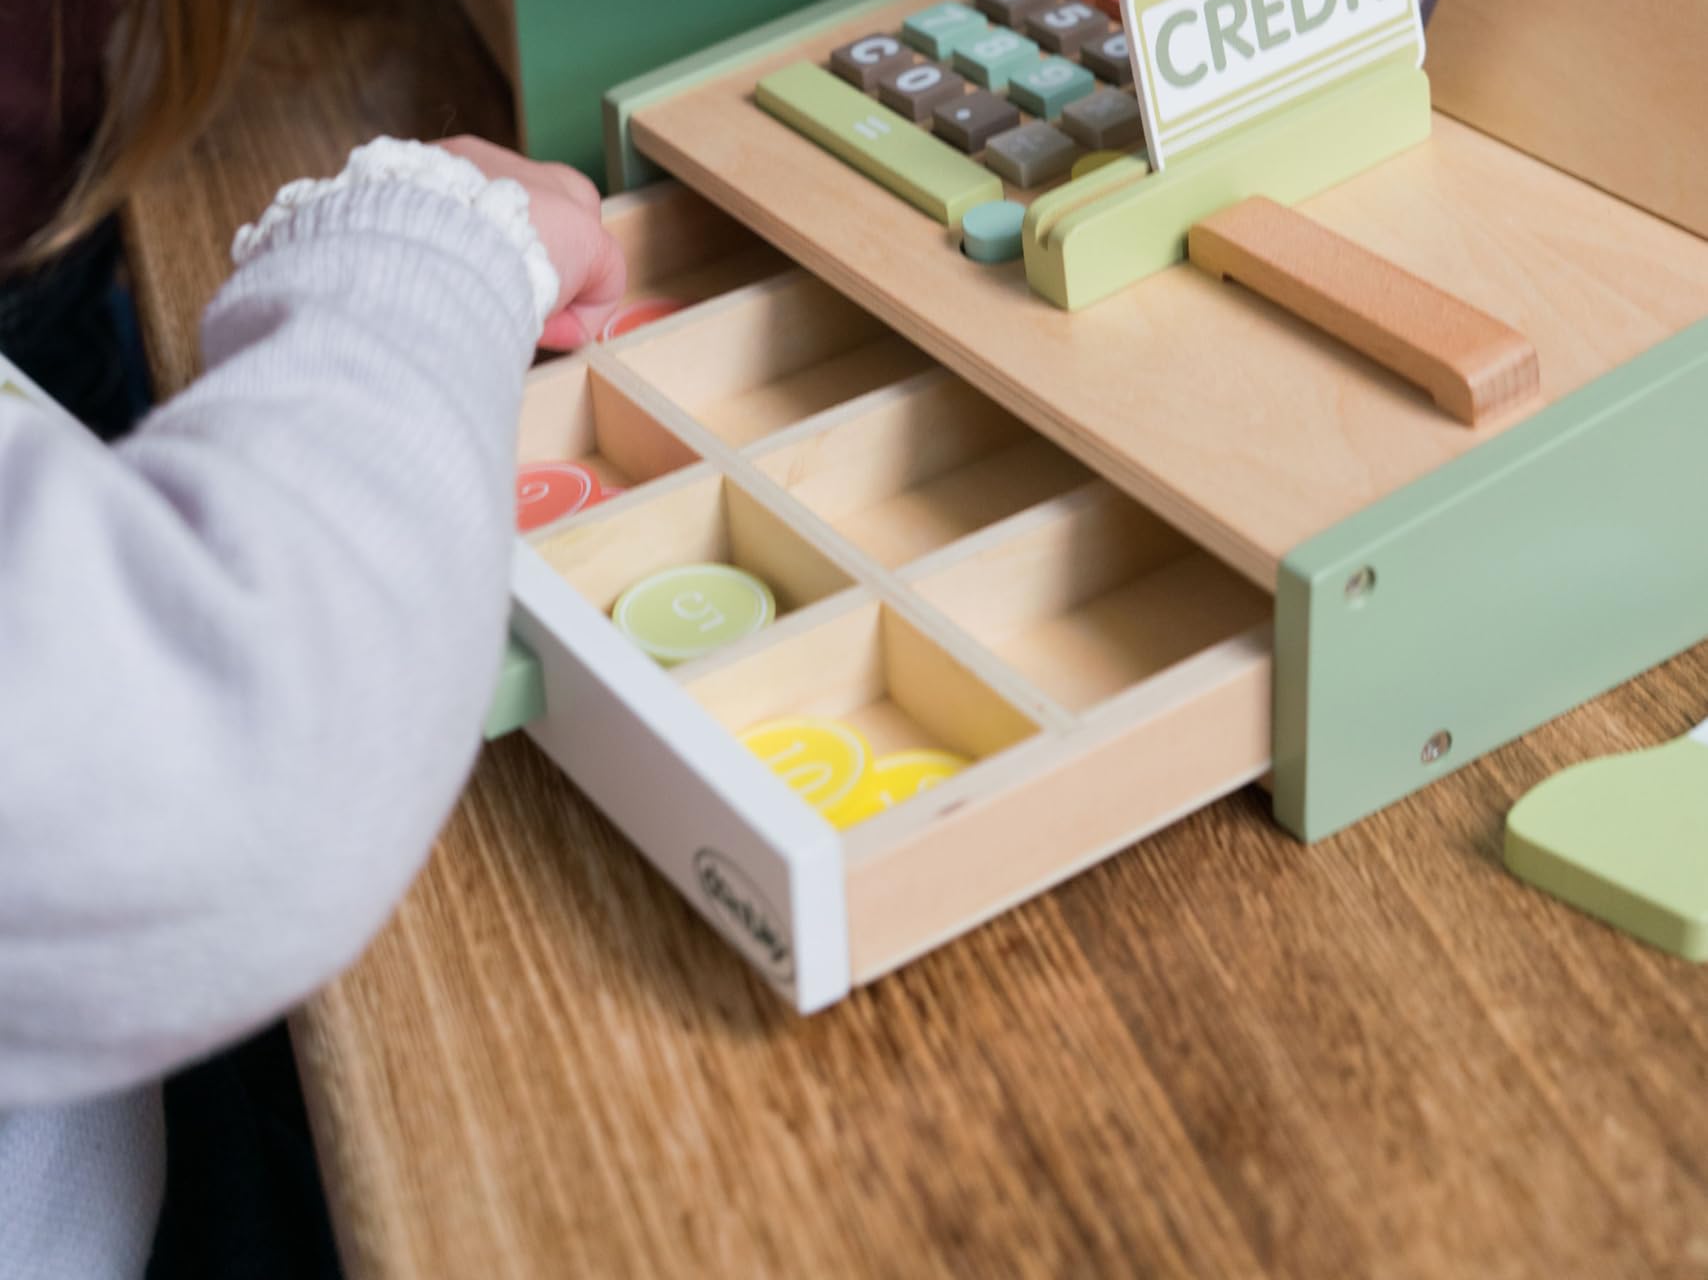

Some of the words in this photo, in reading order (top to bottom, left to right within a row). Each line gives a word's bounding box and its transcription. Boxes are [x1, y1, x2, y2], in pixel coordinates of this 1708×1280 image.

[1044, 3, 1093, 29] 5
[850, 36, 900, 63] C
[973, 34, 1020, 60] 8
[896, 65, 942, 92] 0
[1027, 63, 1075, 88] 9
[671, 590, 726, 632] 5
